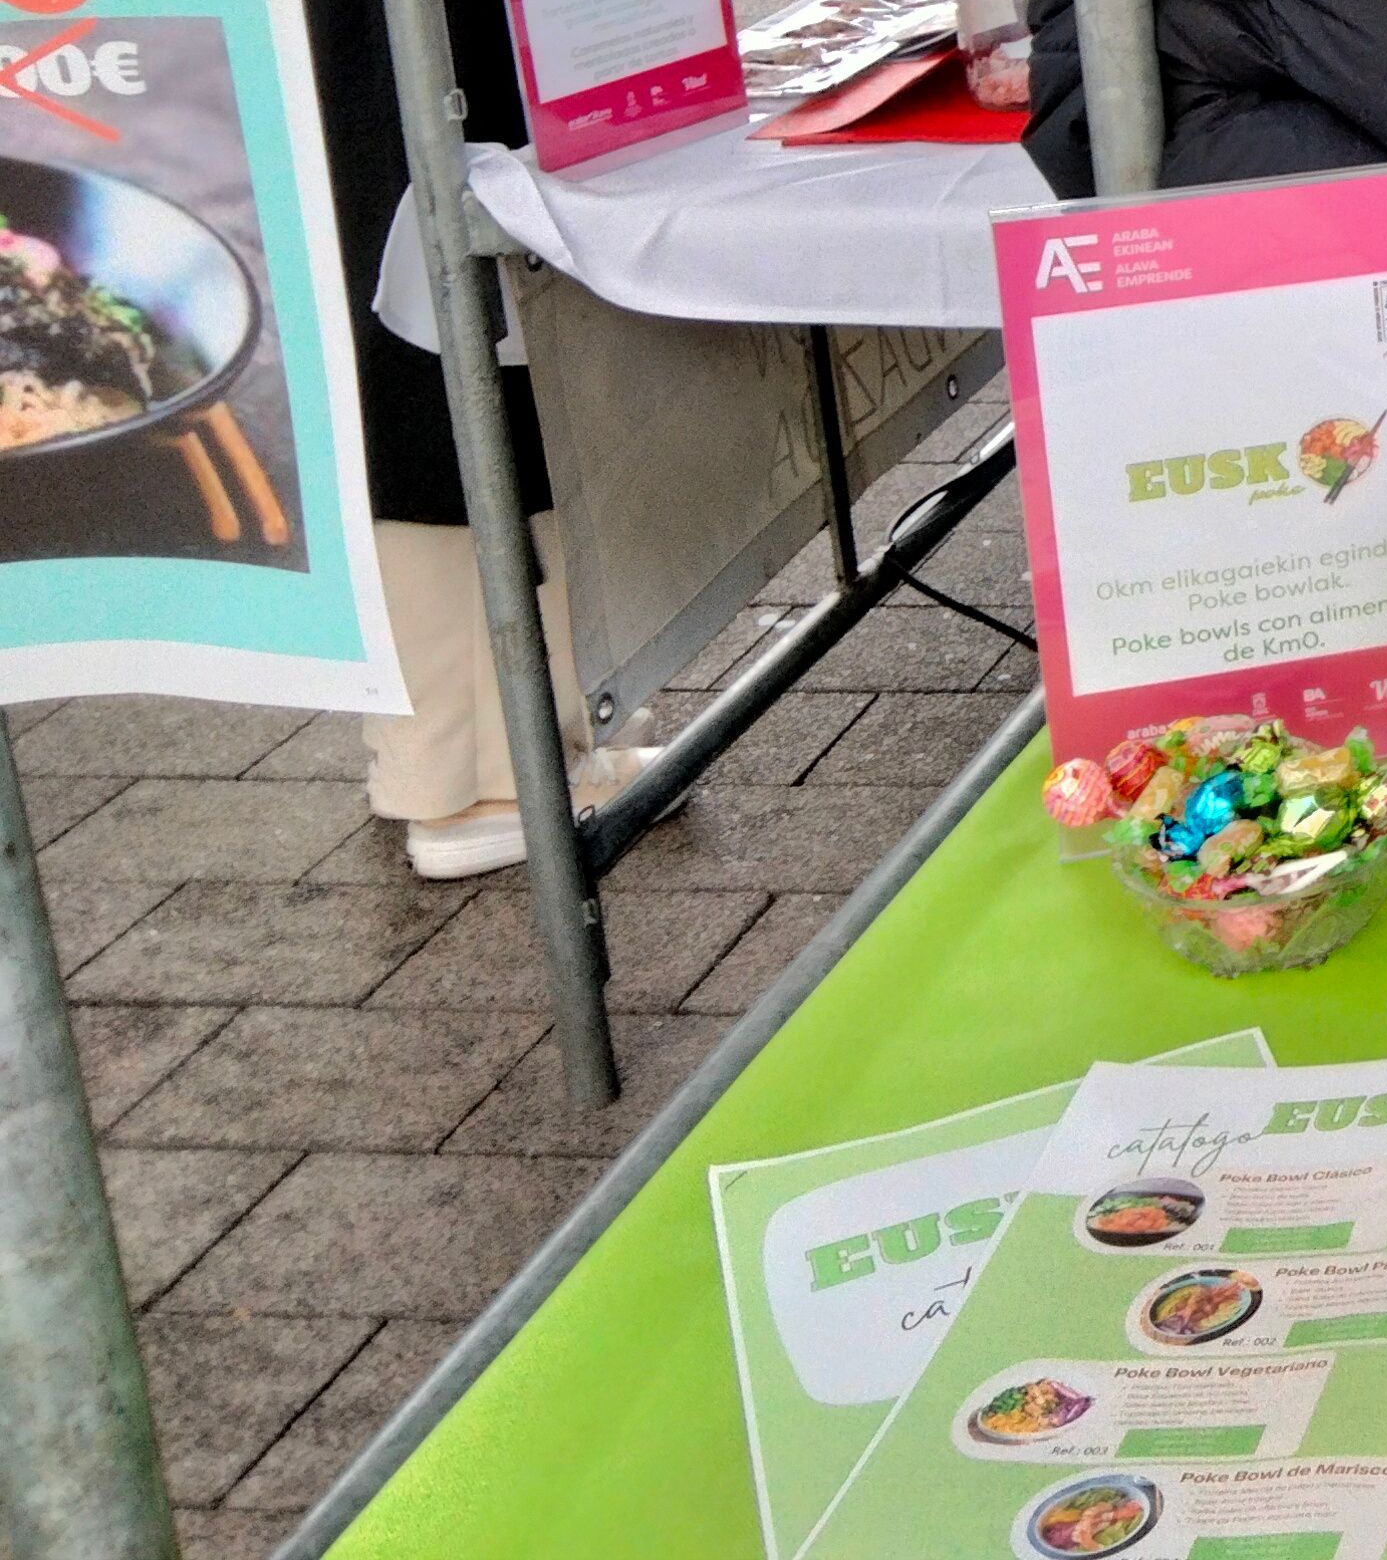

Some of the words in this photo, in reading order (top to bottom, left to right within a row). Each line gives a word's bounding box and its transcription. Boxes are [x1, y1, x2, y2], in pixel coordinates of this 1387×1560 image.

[1111, 227, 1159, 244] ARABA
[1113, 239, 1174, 258] EKINEAN
[1116, 267, 1193, 289] EMPRENDE
[1126, 441, 1290, 503] EUSK
[1161, 553, 1312, 596] elikagaiekin
[1188, 590, 1247, 613] Poke
[1255, 571, 1351, 602] bowlak.
[1112, 628, 1172, 657] Poke
[1180, 617, 1250, 646] bowls
[1257, 612, 1303, 634] con
[1223, 641, 1255, 664] de
[1107, 1112, 1265, 1178] catalogo
[1219, 1171, 1263, 1184] Poke
[1265, 1169, 1309, 1184] Bowl
[804, 1190, 1021, 1293] EUS
[1275, 1267, 1321, 1279] Poke
[1323, 1262, 1369, 1277] Bowl
[1253, 1337, 1277, 1347] 002
[1113, 1366, 1161, 1380] Poke
[1164, 1364, 1214, 1380] Bowl
[1217, 1358, 1329, 1380] Vegetariano
[1082, 1445, 1109, 1457] 003
[1179, 1470, 1230, 1484] Poke
[1233, 1467, 1284, 1483] Bowl
[1286, 1464, 1312, 1478] de
